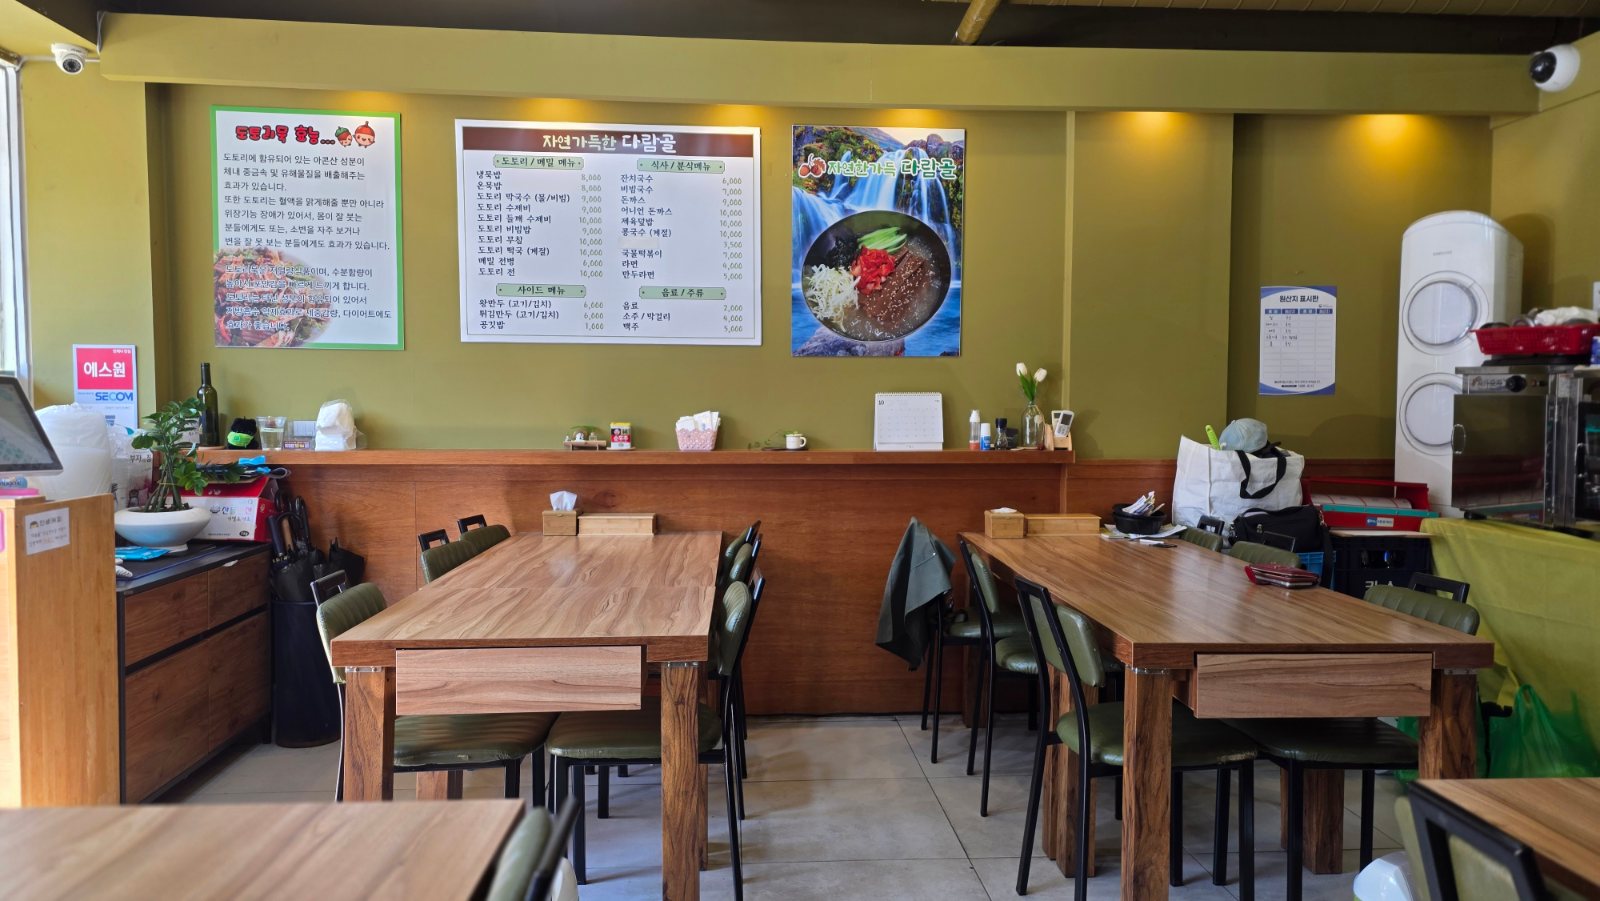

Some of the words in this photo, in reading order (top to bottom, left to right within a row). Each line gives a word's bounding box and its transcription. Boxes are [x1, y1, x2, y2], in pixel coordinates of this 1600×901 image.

[236, 125, 289, 143] 도토리묵
[543, 135, 617, 151] 자연가득한
[622, 134, 676, 153] 다람골
[224, 153, 256, 163] 도토리에
[260, 154, 292, 163] 함유되어
[295, 156, 311, 164] 있는
[313, 156, 338, 165] 아콘산
[340, 157, 364, 166] 성분이
[501, 157, 528, 166] 도토리
[537, 159, 554, 167] 메밀
[558, 159, 576, 168] 메뉴
[651, 161, 669, 170] 식사
[677, 161, 711, 171] 분식메뉴
[827, 159, 896, 178] 자연한가득
[900, 158, 957, 180] 다람골
[224, 167, 240, 175] 체내
[243, 168, 267, 176] 중금속
[270, 169, 278, 177] 및
[281, 169, 321, 178] 유해물질을
[325, 170, 365, 180] 배출해주는
[477, 171, 502, 179] 냉묵밥
[621, 174, 653, 182] 잔치국수
[224, 181, 248, 190] 효과가
[252, 182, 287, 191] 있습니다.
[477, 181, 502, 190] 온묵밥
[621, 185, 653, 194] 비빔국수
[477, 192, 502, 201] 도토리
[506, 193, 531, 202] 막국수
[621, 196, 646, 204] 돈까스
[244, 197, 276, 205] 도토리는
[279, 197, 303, 206] 혈액을
[306, 198, 338, 207] 맑게해줄
[341, 199, 357, 207] 뿐만
[360, 200, 384, 208] 아니라
[477, 203, 502, 212] 도토리
[506, 204, 531, 212] 수제비
[621, 207, 644, 215] 어니언
[648, 208, 672, 216] 돈까스
[225, 210, 257, 218] 위장기능
[260, 210, 285, 219] 장애가
[288, 211, 314, 220] 있어서,
[318, 212, 333, 220] 몸이
[336, 212, 343, 221] 잘
[477, 214, 502, 223] 도토리
[506, 215, 523, 223] 들깨
[527, 215, 552, 224] 수제비
[621, 218, 654, 226] 제육덮밥
[225, 224, 266, 232] 분들에게도
[269, 225, 287, 233] 또는,
[290, 226, 314, 234] 소변을
[318, 226, 333, 235] 자주
[336, 227, 360, 235] 보거나
[478, 225, 502, 233] 도토리
[506, 226, 531, 234] 비빔밥
[621, 228, 646, 236] 콩국수
[649, 229, 672, 238] (계절)
[225, 238, 241, 246] 변을
[245, 238, 252, 246] 잘
[255, 238, 263, 246] 못
[266, 239, 282, 247] 보는
[285, 239, 325, 248] 분들에게도
[355, 241, 390, 250] 있습니다.
[478, 236, 502, 244] 도토리
[478, 246, 503, 255] 도토리
[507, 247, 523, 255] 떡국
[527, 247, 550, 256] (계절)
[622, 250, 662, 258] 국물떡볶이
[478, 257, 494, 265] 메밀
[498, 258, 515, 266] 전병
[622, 260, 638, 268] 라면
[332, 268, 372, 277] 수분함량이
[478, 268, 503, 276] 도토리
[507, 268, 515, 276] 전
[622, 271, 655, 279] 만두라면
[316, 282, 340, 290] 느끼게
[343, 282, 370, 290] 합니다.
[518, 286, 544, 295] 사이드
[548, 286, 565, 295] 메뉴
[662, 288, 678, 297] 음료
[687, 289, 704, 297] 주류
[343, 296, 367, 304] 있어서
[479, 299, 505, 308] 왕만두
[508, 300, 552, 309] (고기/김치)
[623, 302, 639, 310] 음료
[344, 310, 391, 318] 다이어트에도
[480, 310, 512, 318] 튀김만두
[516, 311, 559, 320] (고기/김치)
[623, 313, 639, 321] 소주
[647, 313, 670, 321] 막걸리
[480, 321, 505, 330] 공깃밥
[84, 362, 126, 378] 에스원
[96, 392, 133, 401] SECOM
